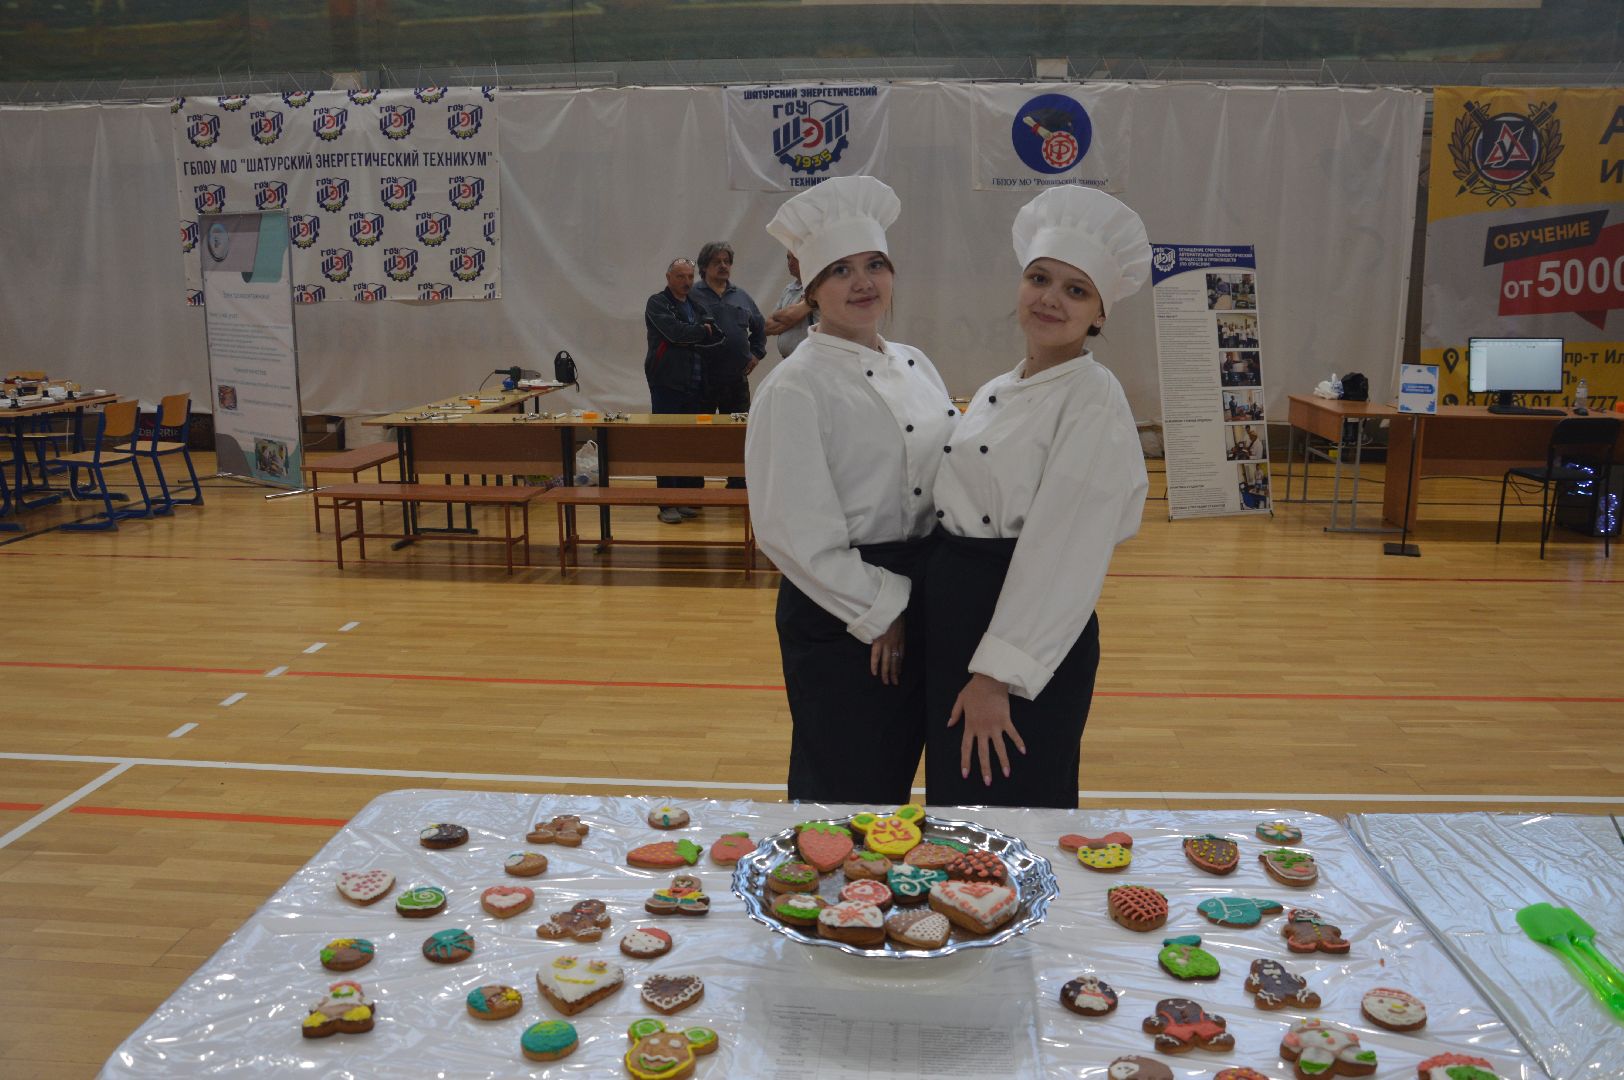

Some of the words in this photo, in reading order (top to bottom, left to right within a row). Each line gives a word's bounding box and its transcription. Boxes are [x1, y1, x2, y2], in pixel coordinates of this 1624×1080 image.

[744, 88, 797, 99] ШАТУРСКИЙ
[801, 86, 877, 96] ЭНЕРГЕТИЧЕСКИЙ
[773, 100, 807, 118] ГОУ
[184, 161, 216, 176] ГБПОУ
[221, 159, 236, 172] МО
[241, 154, 312, 172] "ШАТУРСКИЙ
[316, 150, 418, 168] ЭНЕРГЕТИЧЕСКИЙ
[423, 152, 492, 167] ТЕХНИКУМ"
[795, 149, 832, 168] 1935
[790, 177, 831, 186] ТЕХНИК
[1494, 220, 1591, 250] ОБУЧЕНИЕ
